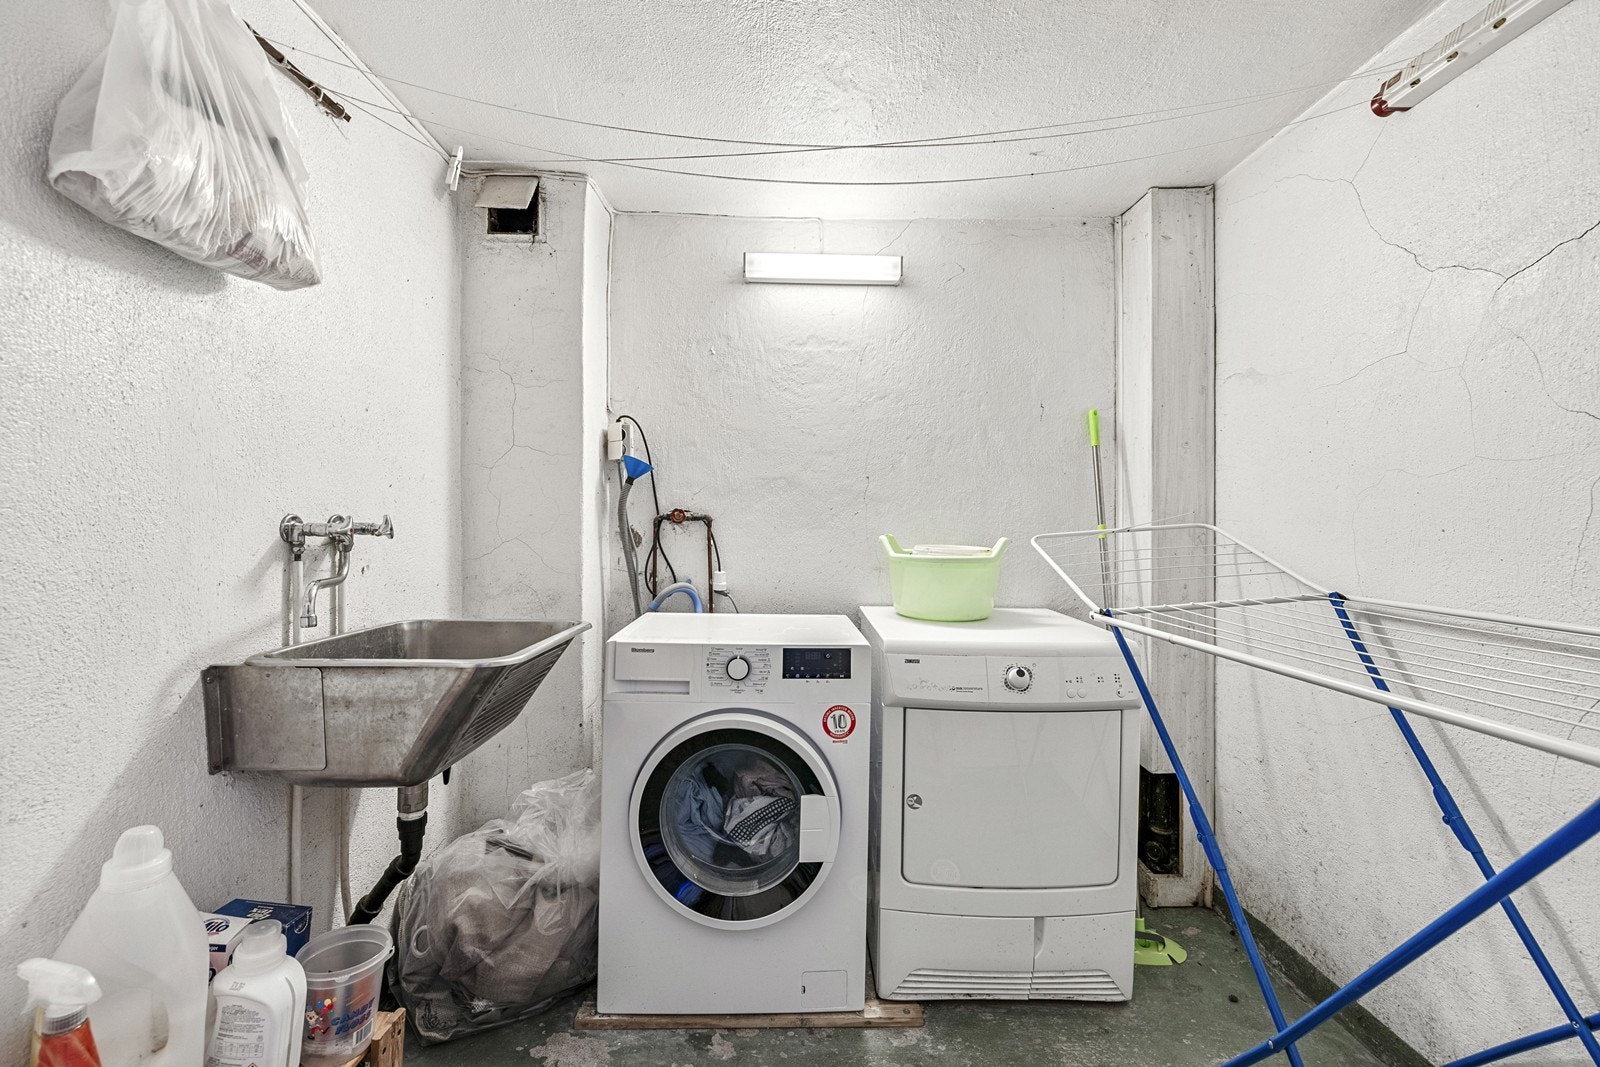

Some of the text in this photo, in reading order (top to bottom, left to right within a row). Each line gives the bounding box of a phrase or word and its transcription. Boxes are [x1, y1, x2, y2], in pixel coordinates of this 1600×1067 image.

[830, 714, 847, 729] 10
[331, 997, 375, 1026] CANDY
[335, 1010, 371, 1035] FLOSS
